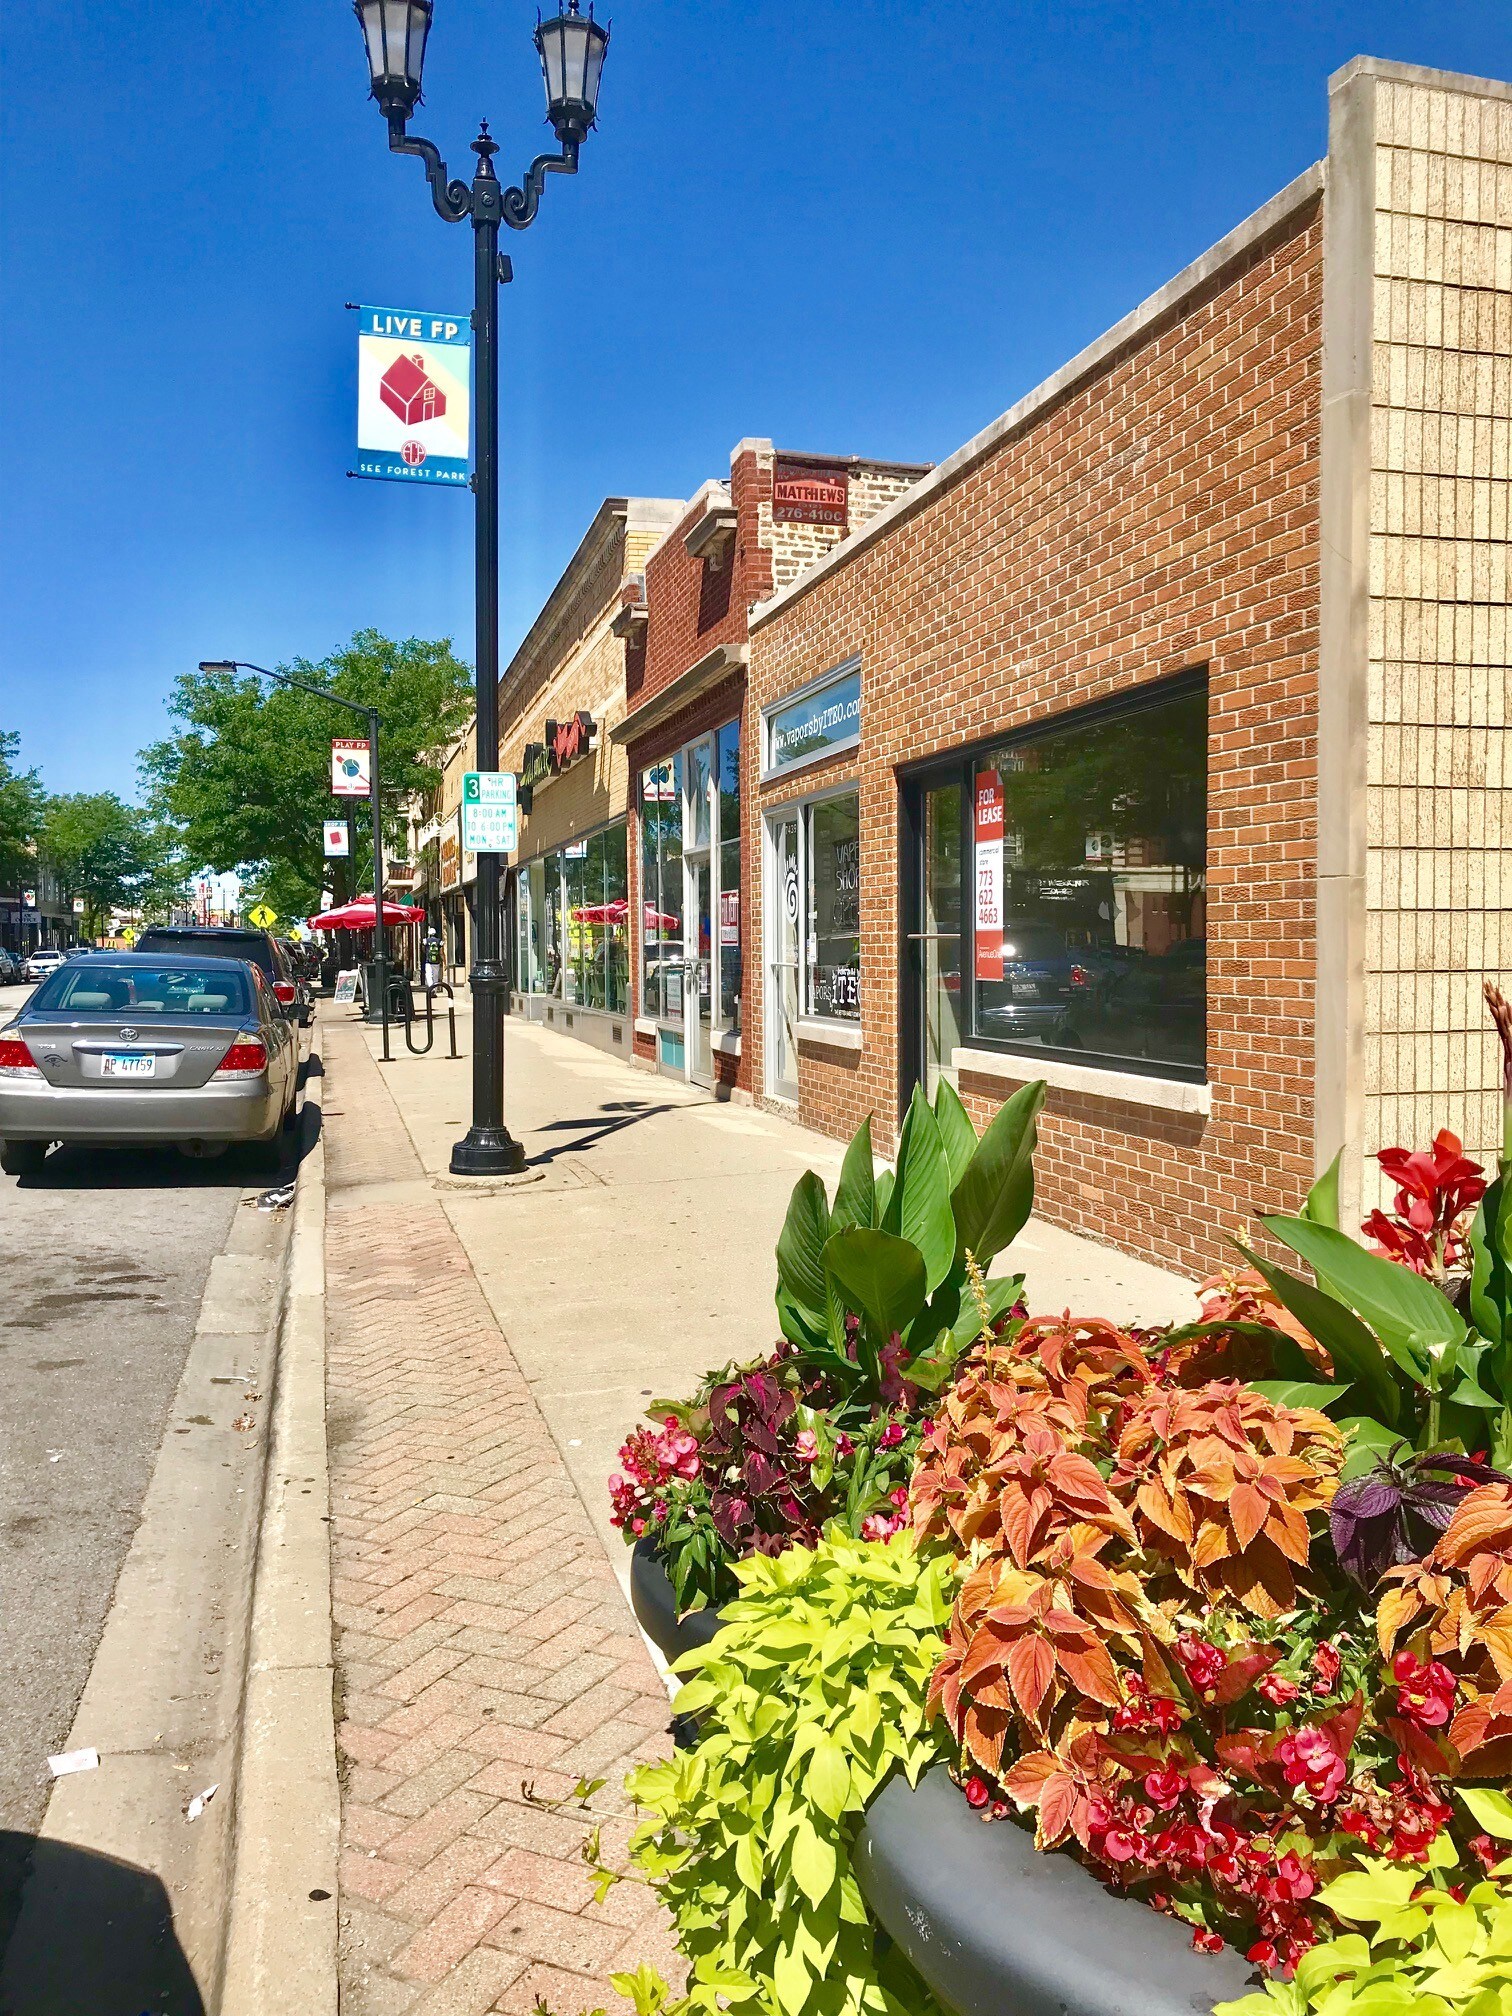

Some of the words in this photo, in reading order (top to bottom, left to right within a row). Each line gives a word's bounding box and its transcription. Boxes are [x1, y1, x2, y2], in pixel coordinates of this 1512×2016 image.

[373, 315, 422, 336] LIVE
[431, 321, 458, 340] FP
[360, 463, 381, 473] SEE
[387, 466, 431, 478] FOREST
[436, 470, 466, 481] PARK
[777, 484, 844, 503] MATTHEWS
[468, 779, 479, 798] 3
[481, 789, 512, 799] PARKING
[978, 787, 995, 807] FOR
[473, 809, 493, 818] 8:00
[495, 809, 507, 818] AM
[978, 805, 1003, 826] LEASE
[467, 821, 476, 831] TO
[481, 821, 500, 832] 6:00
[502, 823, 514, 832] PM
[469, 835, 487, 844] MON
[496, 835, 511, 845] SAT
[836, 841, 859, 864] VAPE
[978, 870, 993, 886] 773
[978, 889, 993, 905] 622
[978, 907, 998, 924] 4663
[104, 1059, 117, 1071] AP
[121, 1059, 152, 1071] 47759
